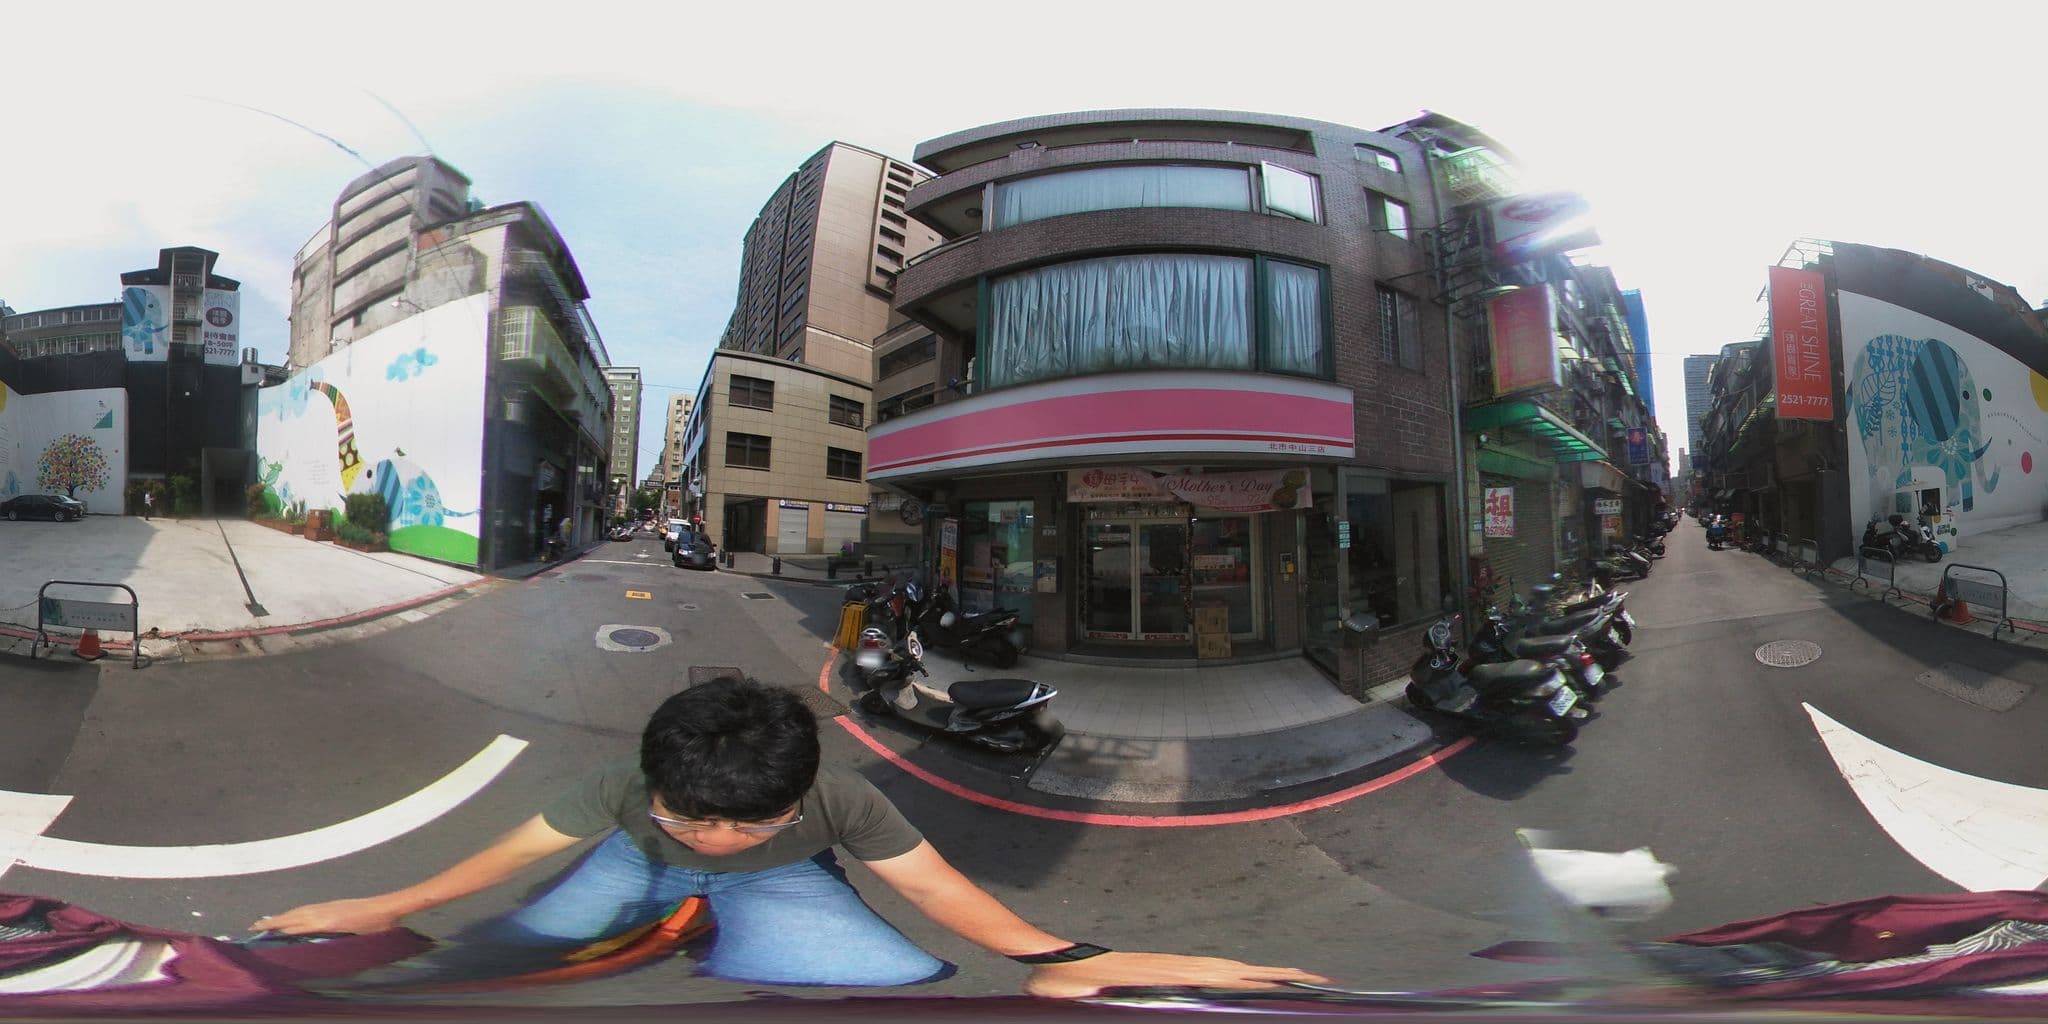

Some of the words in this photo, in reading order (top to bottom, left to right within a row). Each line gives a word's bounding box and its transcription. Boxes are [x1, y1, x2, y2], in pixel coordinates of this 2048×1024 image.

[1799, 289, 1818, 333] GREAT
[1802, 336, 1822, 383] SHINE
[1781, 394, 1828, 406] 2521-7777
[1240, 479, 1272, 493] Day
[1486, 489, 1512, 516] 租
